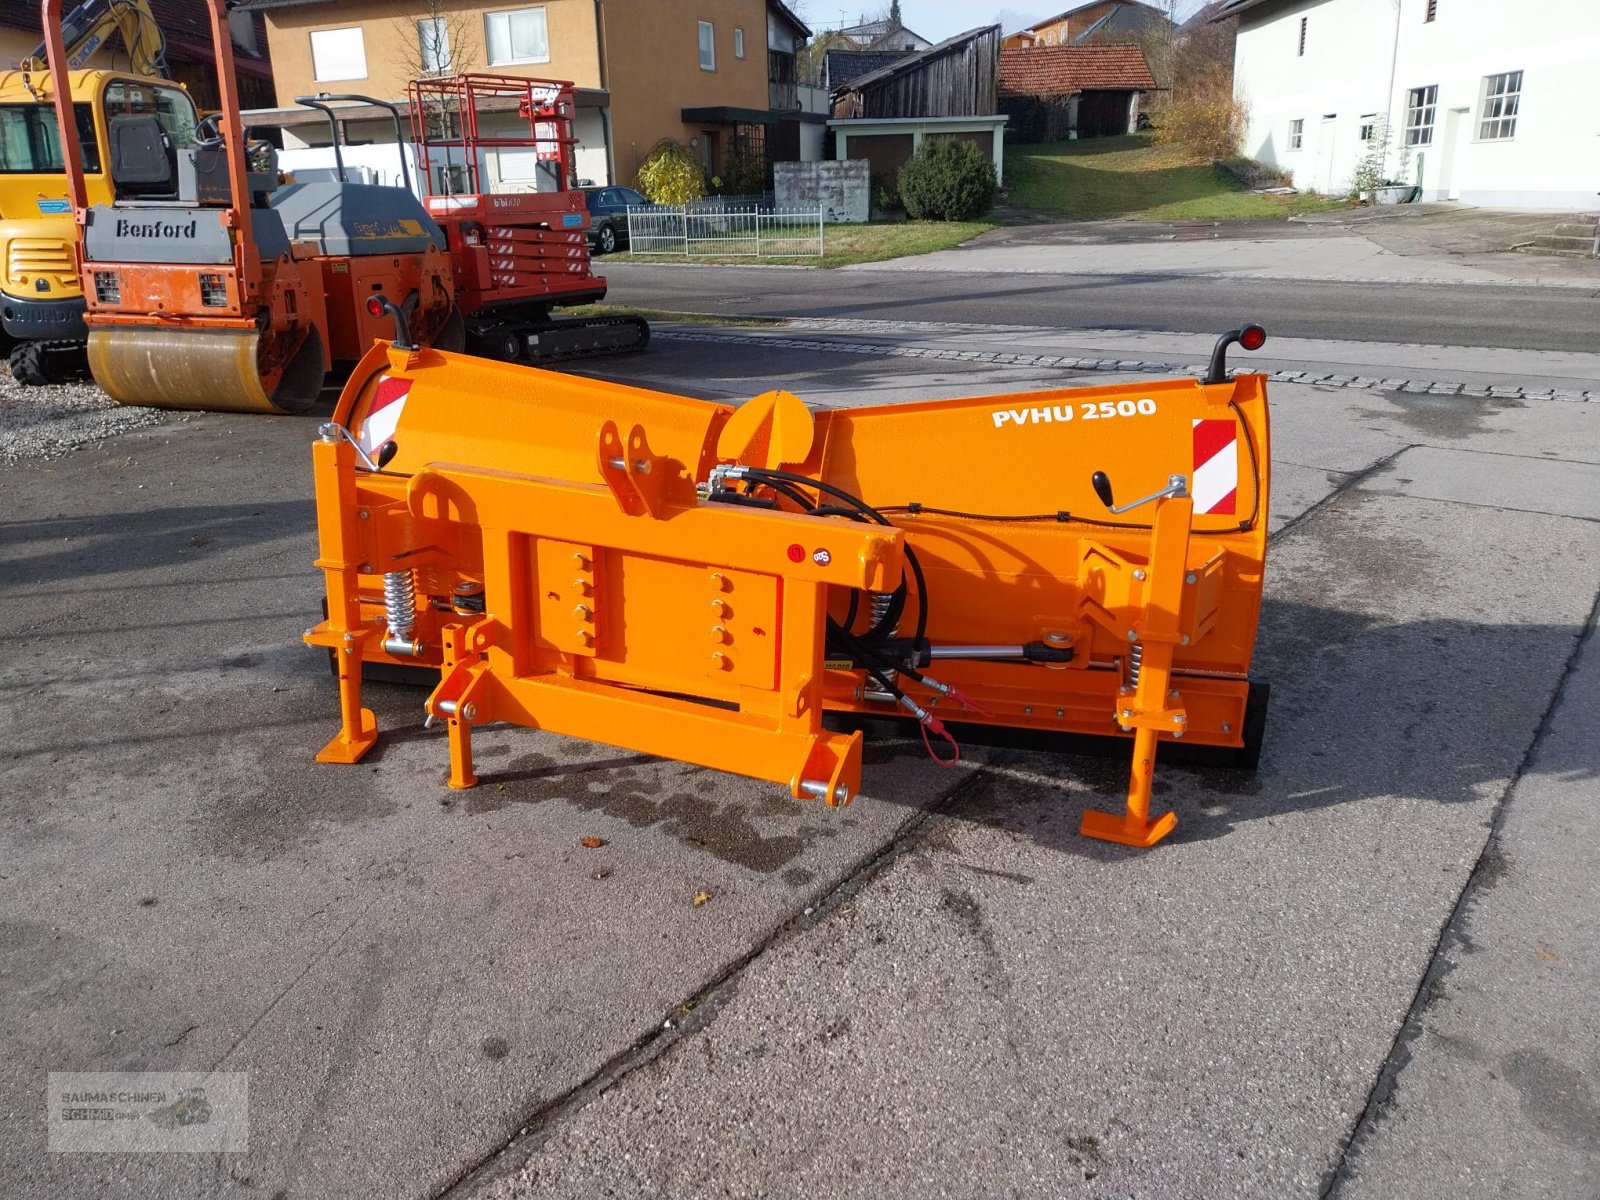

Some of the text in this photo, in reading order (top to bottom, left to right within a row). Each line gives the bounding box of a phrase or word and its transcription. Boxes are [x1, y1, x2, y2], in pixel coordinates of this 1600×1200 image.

[116, 219, 197, 239] Benford
[992, 398, 1157, 428] PVHU 2500
